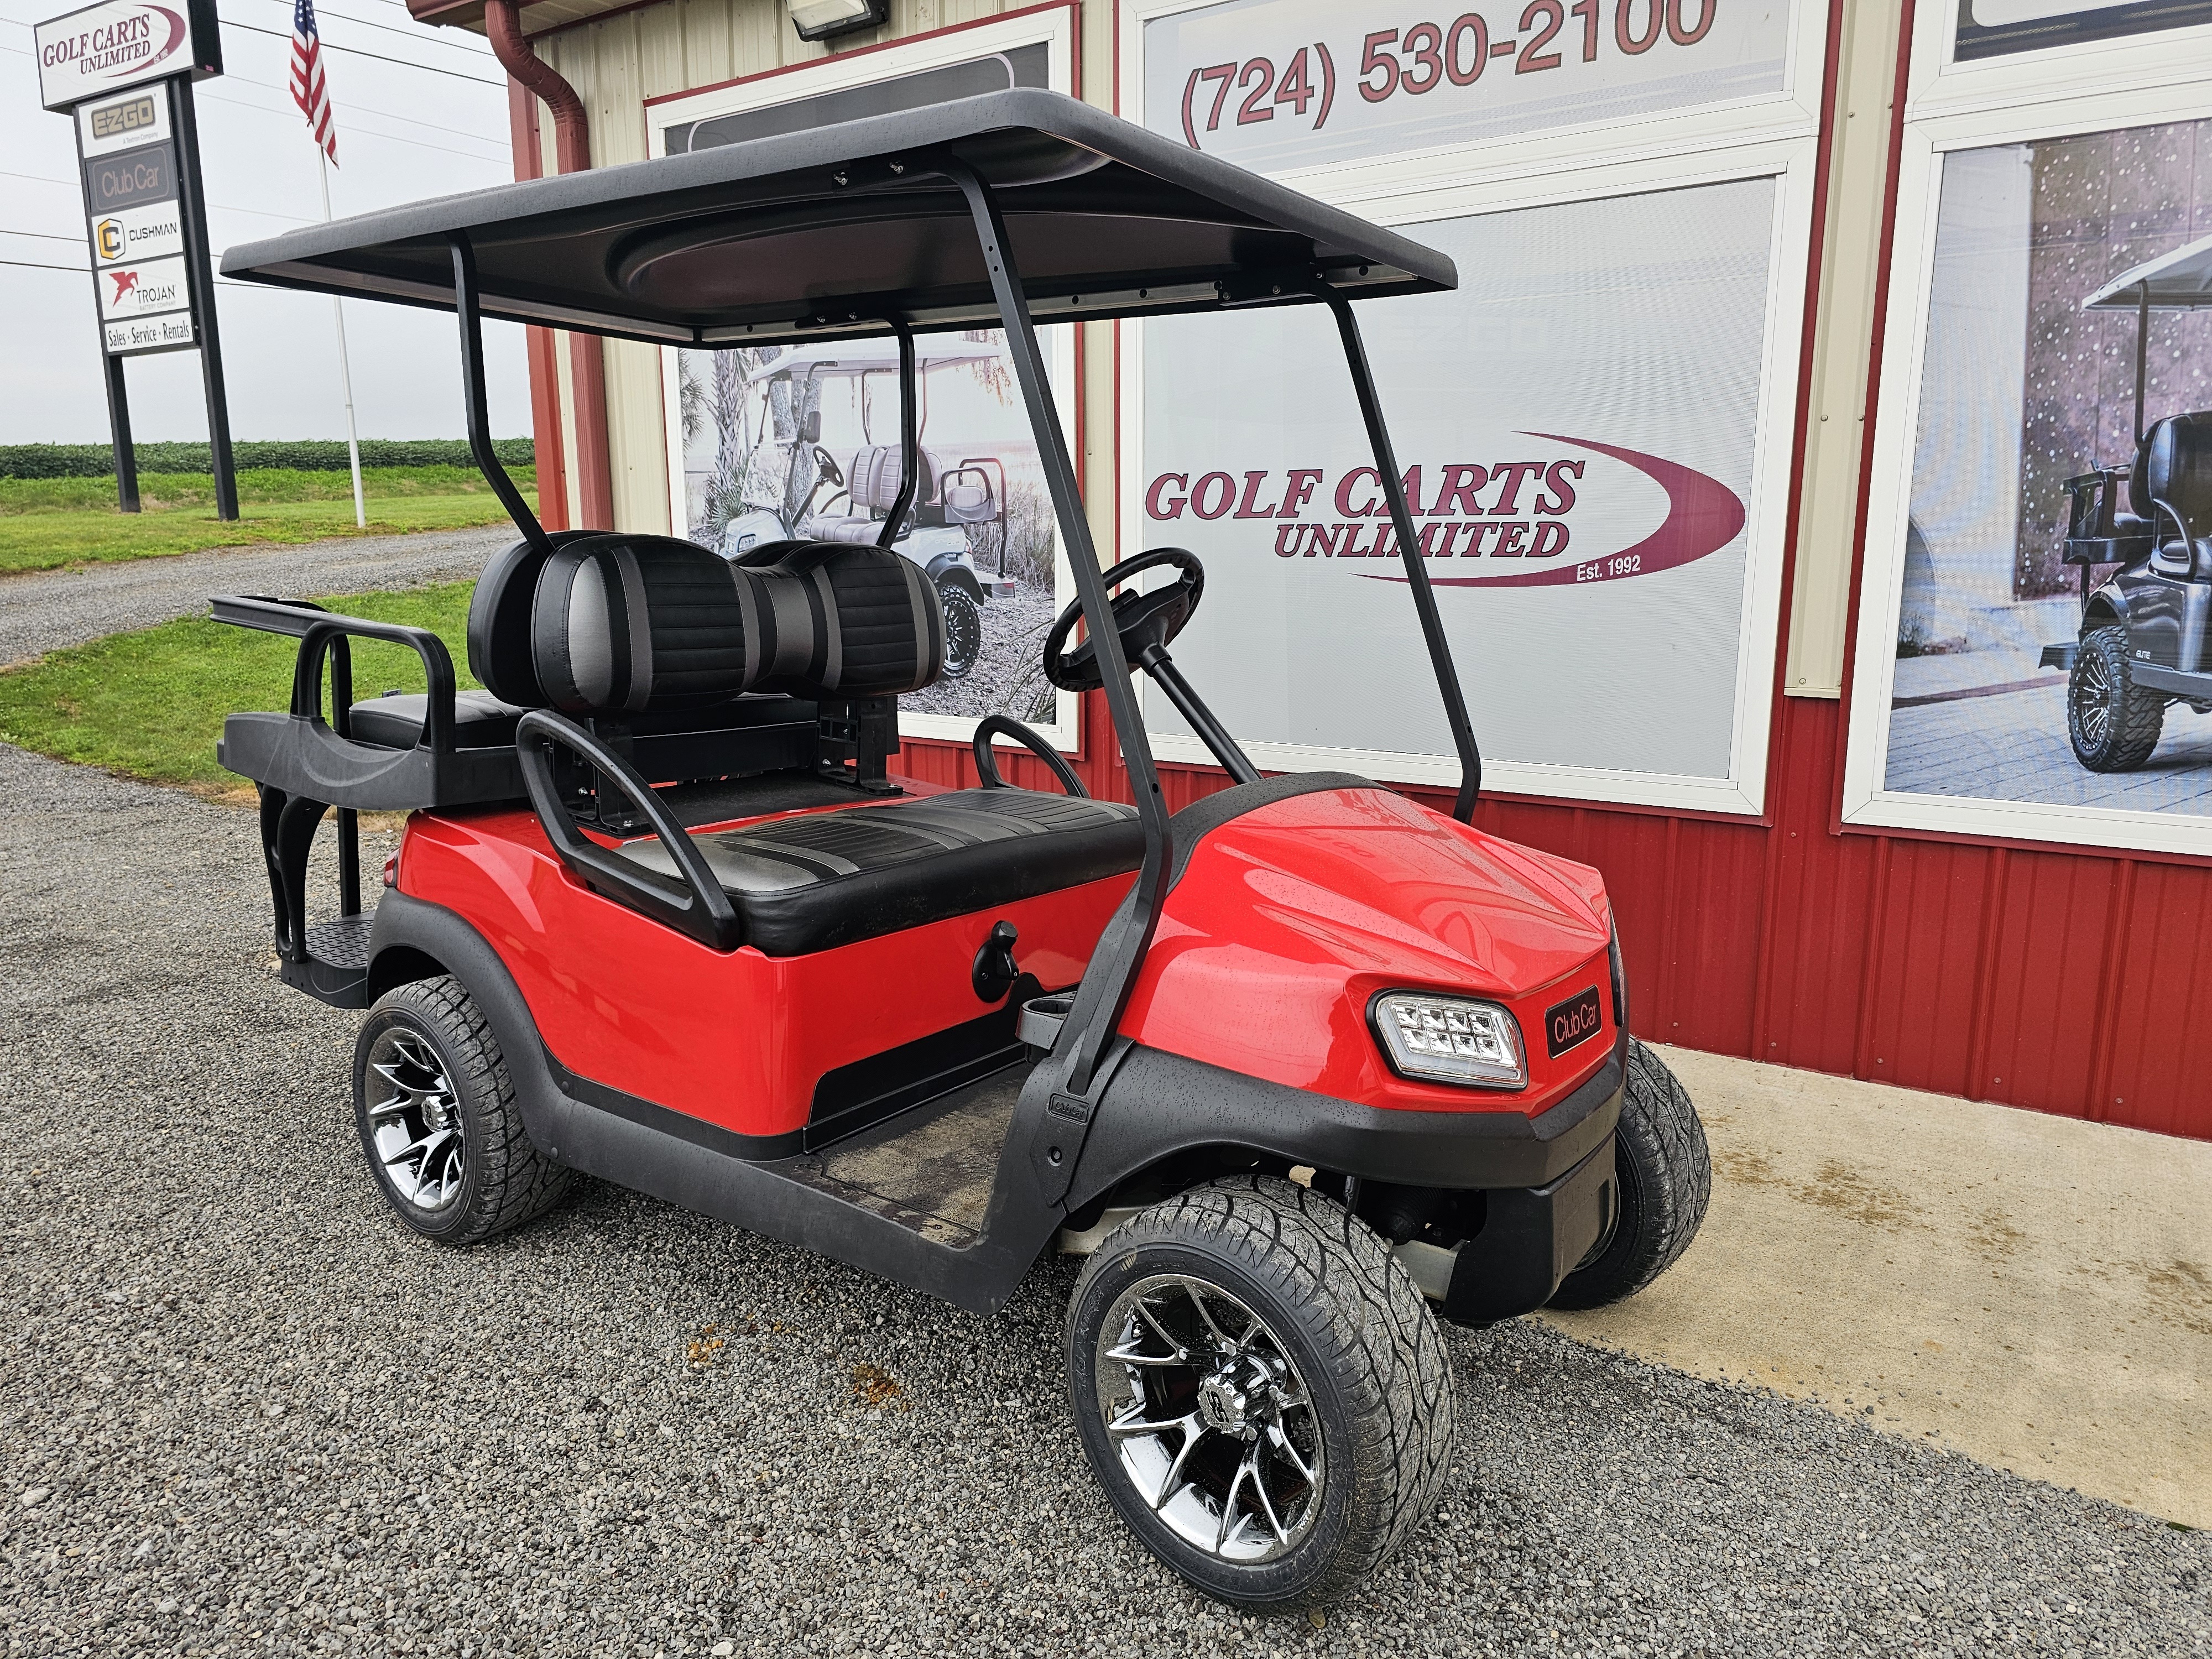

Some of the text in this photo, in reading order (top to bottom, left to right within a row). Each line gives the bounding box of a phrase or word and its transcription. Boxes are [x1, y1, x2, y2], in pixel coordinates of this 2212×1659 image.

[44, 13, 149, 67] GOLF CARTS
[81, 40, 150, 75] UNLIMITED
[1181, 0, 1717, 149] (724) 530-2100
[102, 164, 159, 197] Club Car
[129, 222, 177, 241] CUSHMAN
[137, 285, 176, 304] TROJAN
[108, 320, 190, 347] Sales Service Rentals
[1145, 460, 1585, 520] GOLF CARTS
[1275, 521, 1570, 558] UNLIMITED
[1577, 555, 1641, 581] Est. 1992
[1554, 1004, 1596, 1043] Club Car
